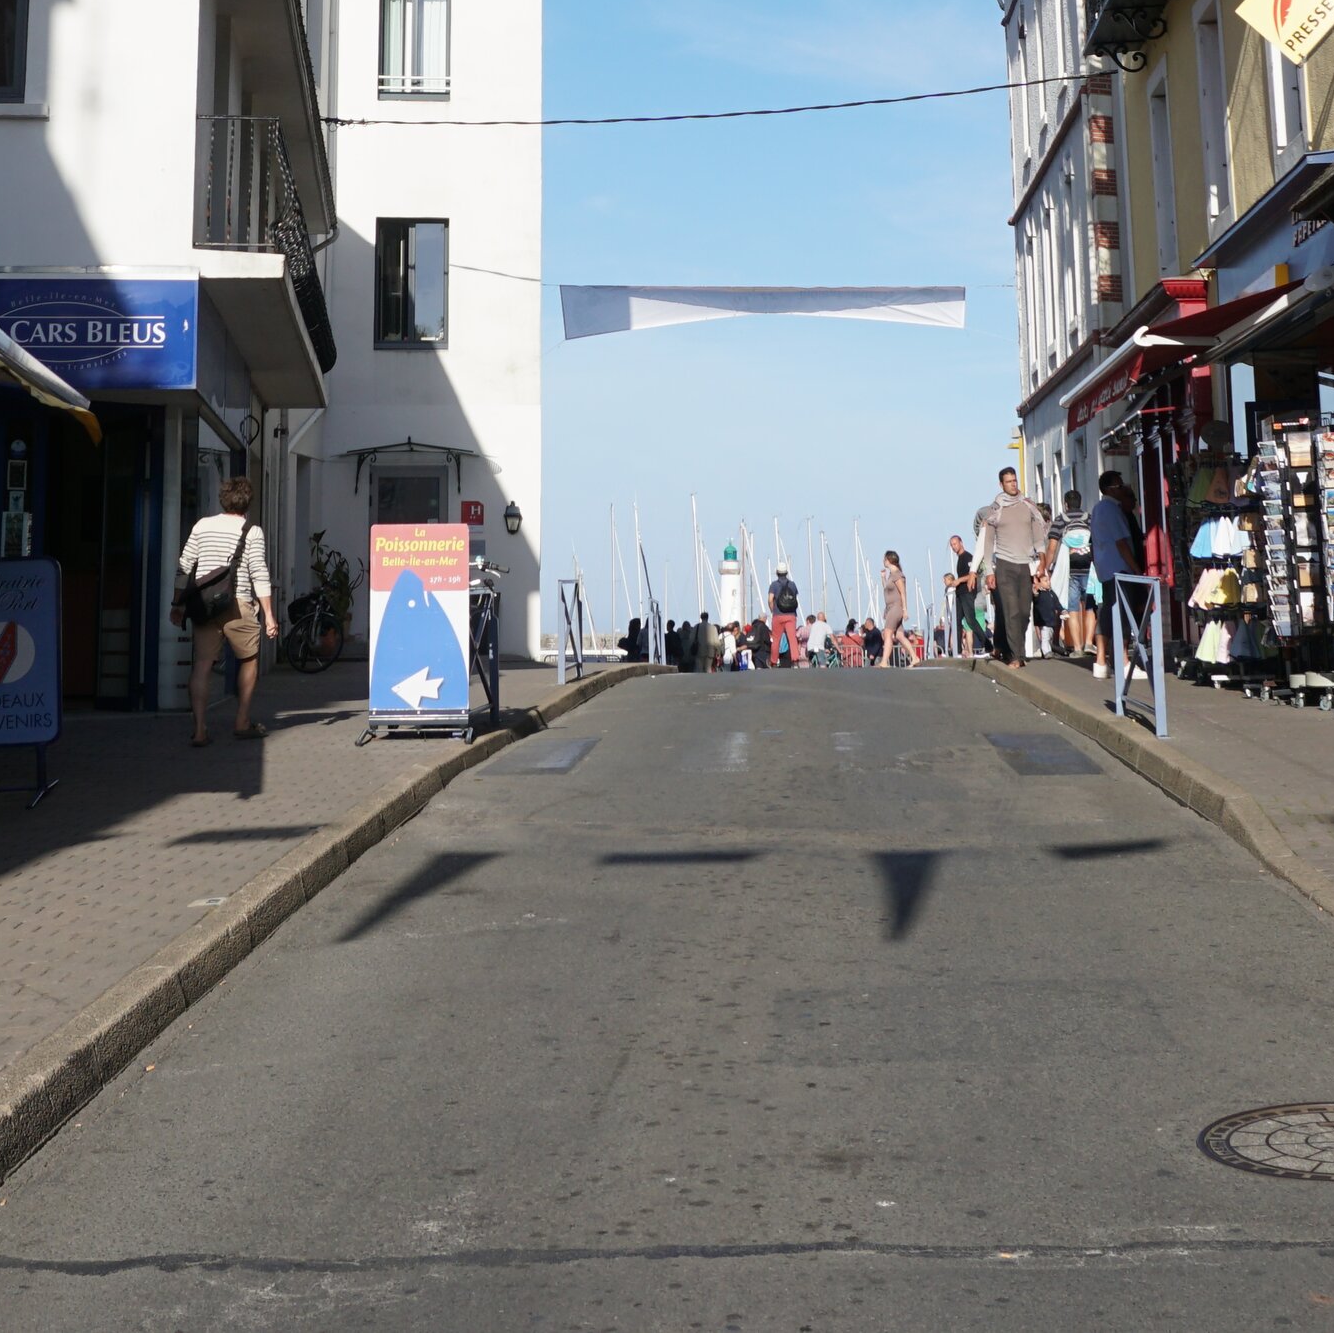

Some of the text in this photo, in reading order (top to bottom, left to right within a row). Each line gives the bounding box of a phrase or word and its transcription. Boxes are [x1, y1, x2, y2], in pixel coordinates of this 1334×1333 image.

[9, 319, 77, 344] CARS
[86, 320, 166, 344] BLEUS
[471, 505, 481, 515] H
[414, 528, 426, 537] La
[375, 536, 465, 552] Poissonnerie
